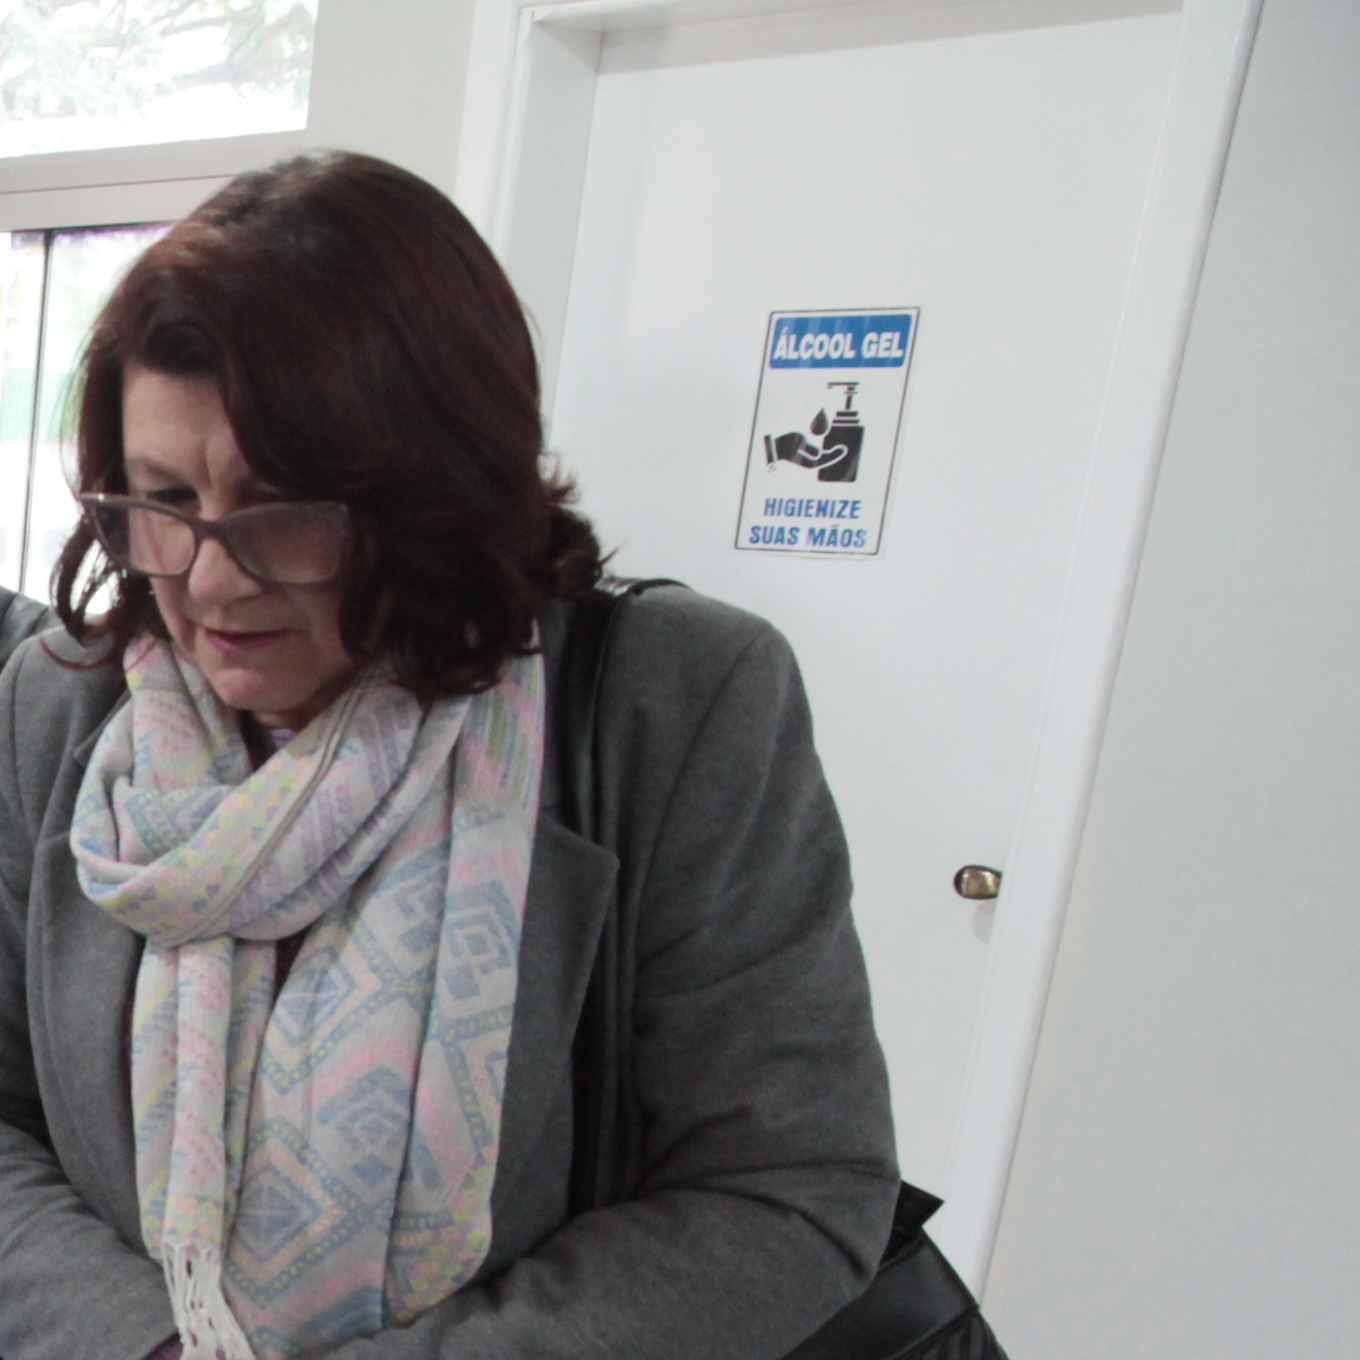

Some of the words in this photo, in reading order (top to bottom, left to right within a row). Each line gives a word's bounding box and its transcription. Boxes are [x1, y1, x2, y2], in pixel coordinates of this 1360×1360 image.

[773, 326, 856, 360] ÁLCOOL
[861, 331, 904, 359] GEL
[763, 498, 862, 519] HIGIENIZE
[749, 525, 800, 545] SUAS
[806, 524, 868, 548] MÃOS
